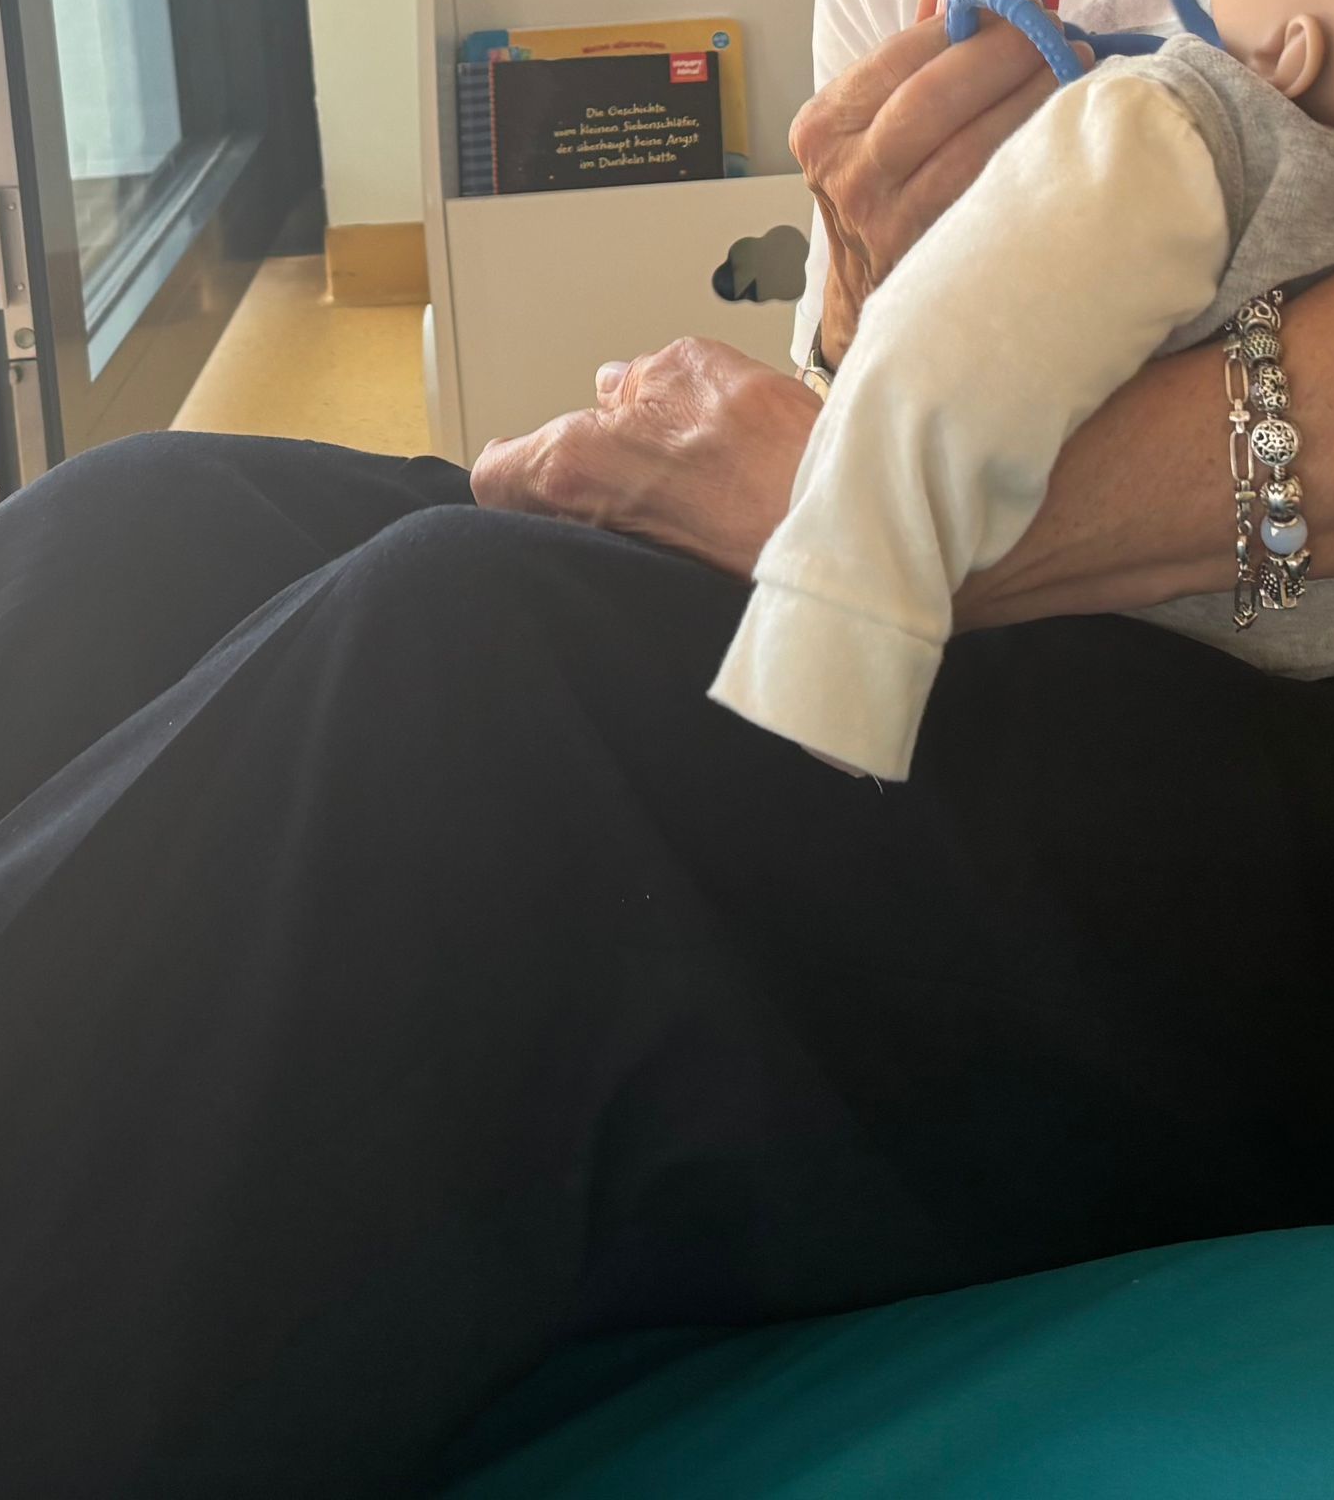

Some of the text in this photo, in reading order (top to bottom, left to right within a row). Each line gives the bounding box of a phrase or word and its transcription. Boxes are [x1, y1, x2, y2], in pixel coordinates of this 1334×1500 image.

[585, 102, 667, 119] Die Geschichte
[579, 123, 619, 136] kleinen
[622, 116, 700, 133] Siebenschläfer,
[555, 132, 700, 155] der überhaupt keine Angst
[578, 151, 678, 170] im Dunkeln hatte
